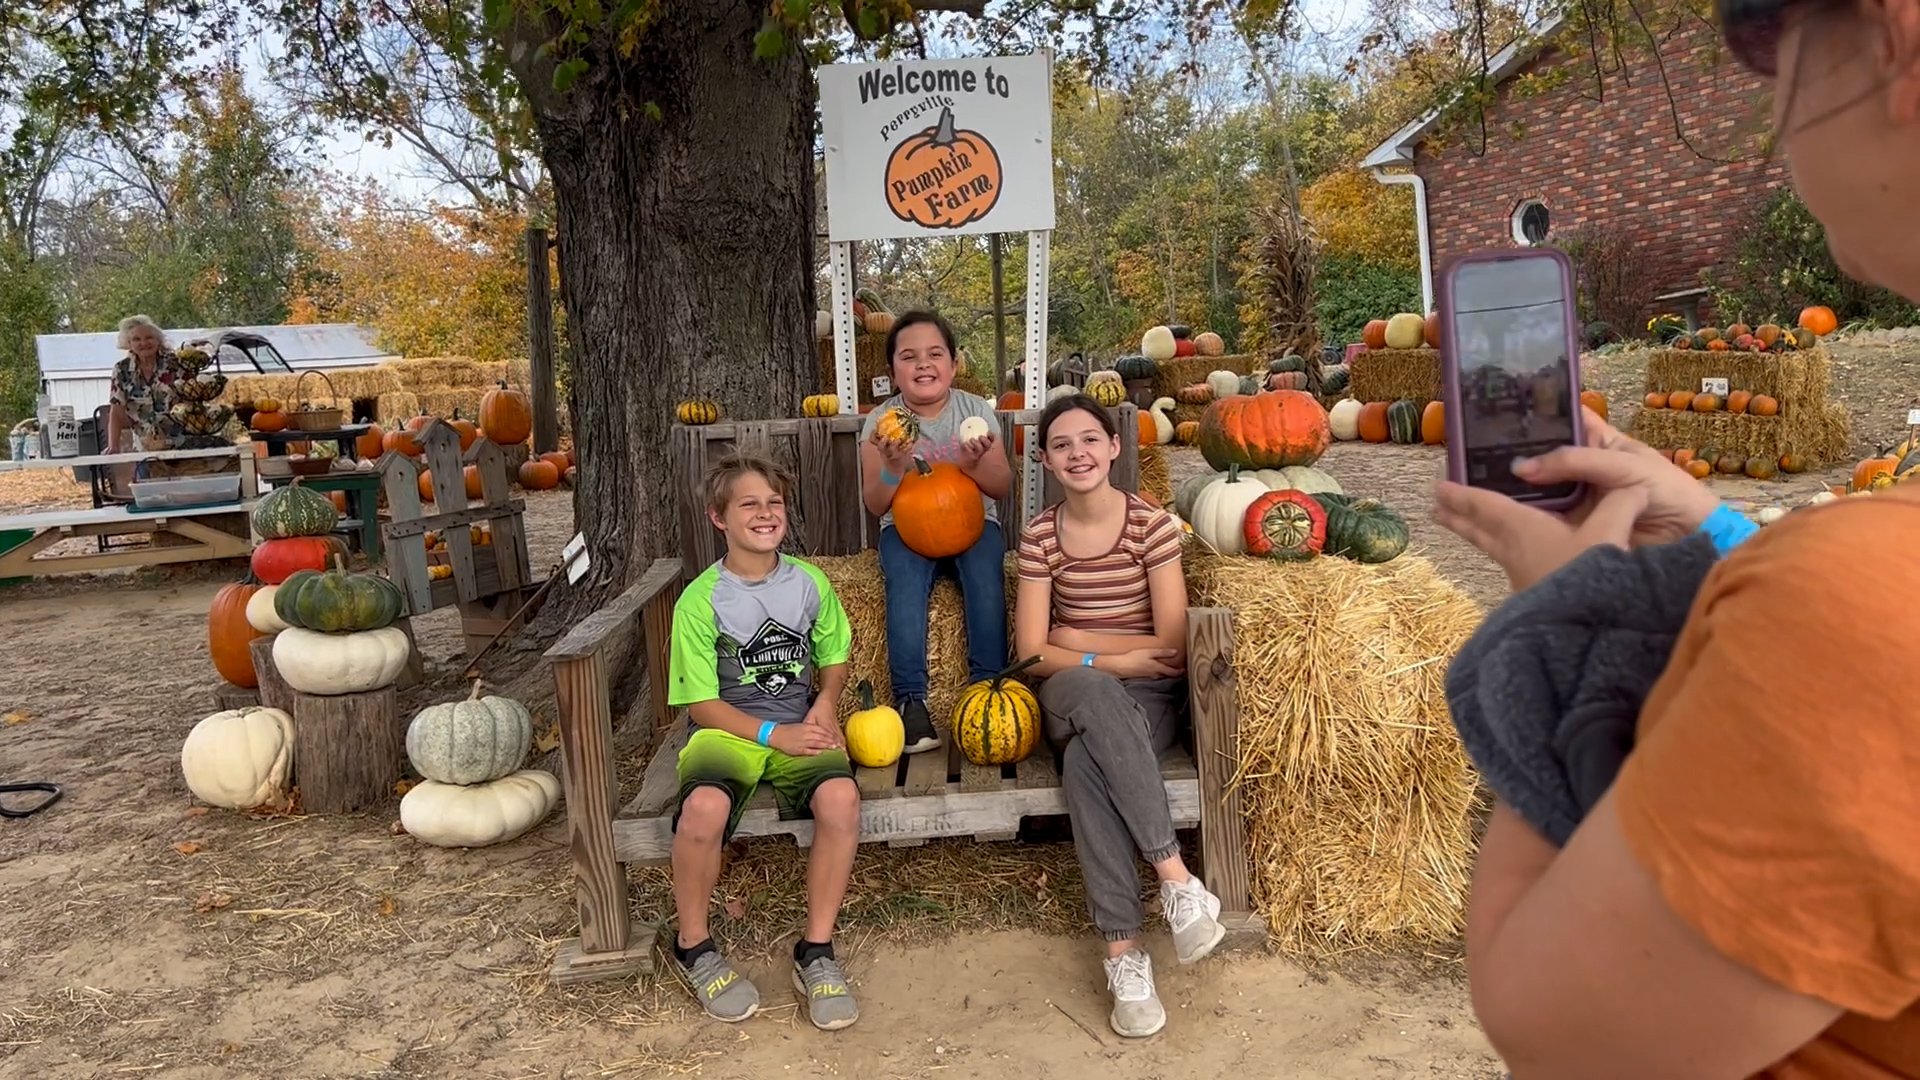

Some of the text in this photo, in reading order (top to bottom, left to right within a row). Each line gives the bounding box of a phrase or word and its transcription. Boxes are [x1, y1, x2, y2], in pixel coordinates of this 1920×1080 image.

[858, 65, 1009, 104] Welcome to
[880, 95, 955, 142] Perryville
[891, 151, 972, 202] Pumpkin
[924, 173, 993, 220] Farm
[706, 970, 739, 999] FILA
[812, 985, 848, 998] FILA
